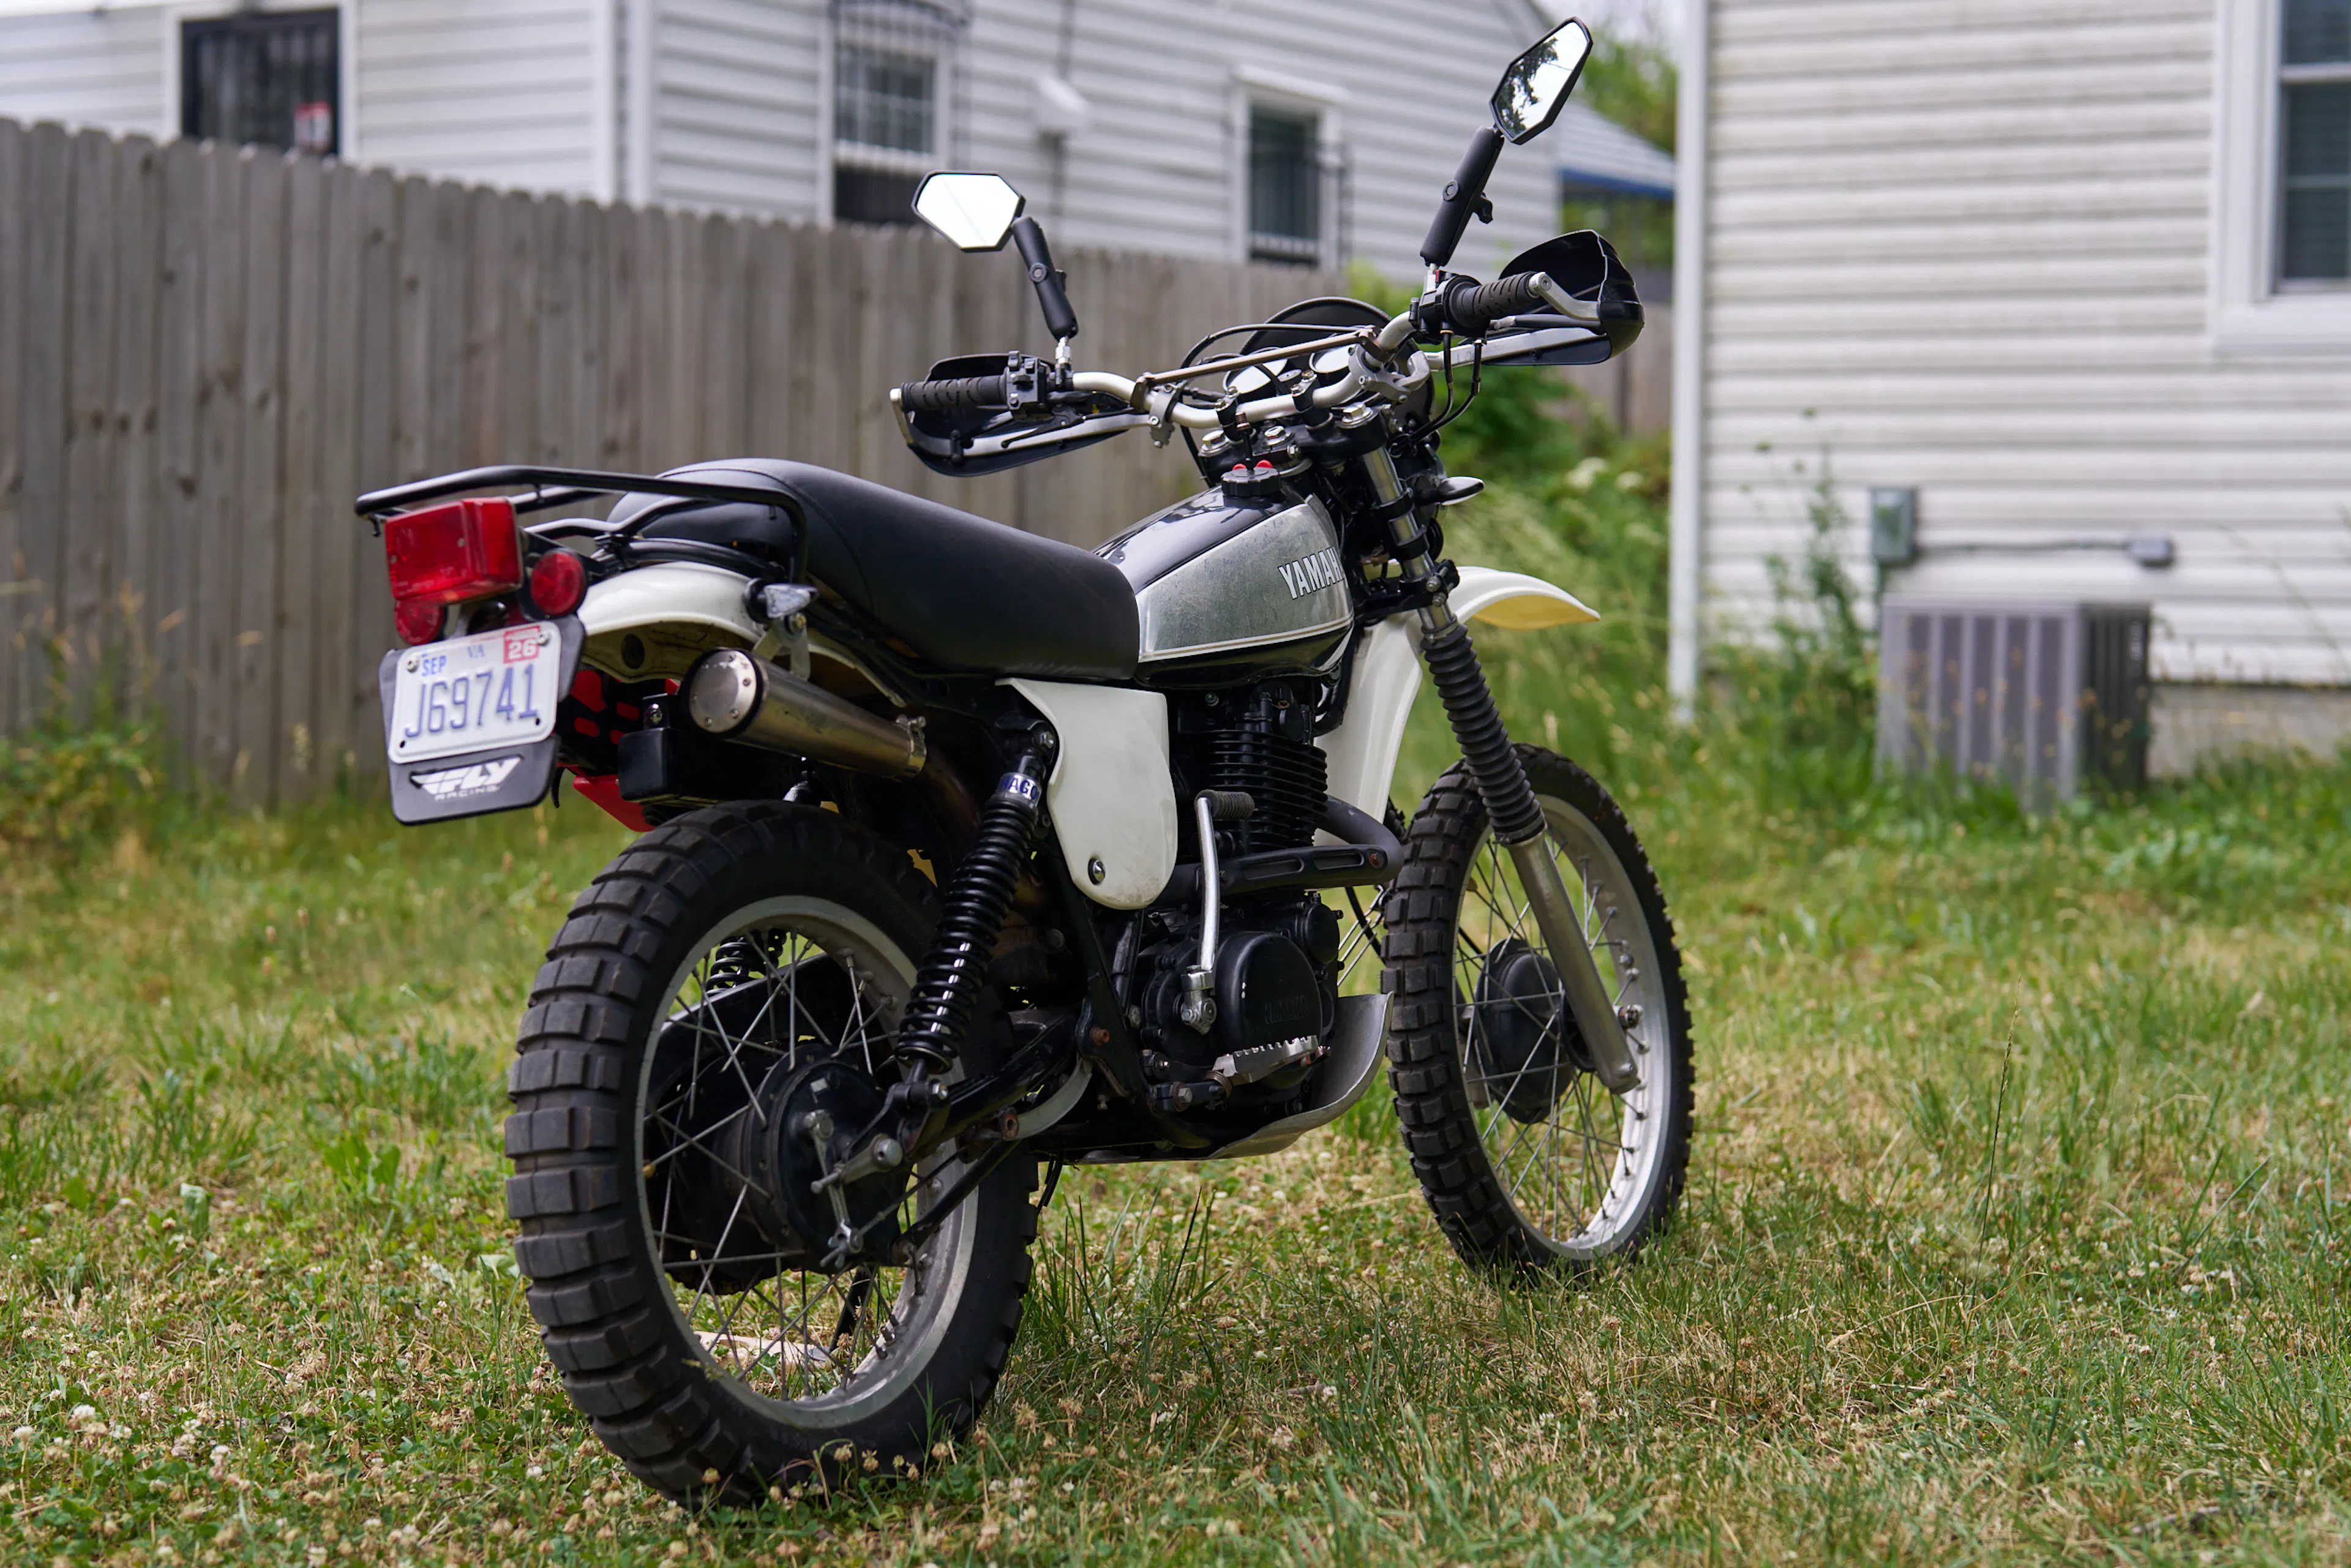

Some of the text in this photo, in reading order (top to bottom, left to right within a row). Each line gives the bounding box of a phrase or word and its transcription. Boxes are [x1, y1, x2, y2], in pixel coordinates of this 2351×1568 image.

[467, 644, 485, 659] VA
[508, 639, 537, 659] 26
[422, 655, 447, 677] SEP
[405, 664, 538, 738] J69741
[411, 757, 522, 795] FLY
[999, 776, 1040, 800] HAGO
